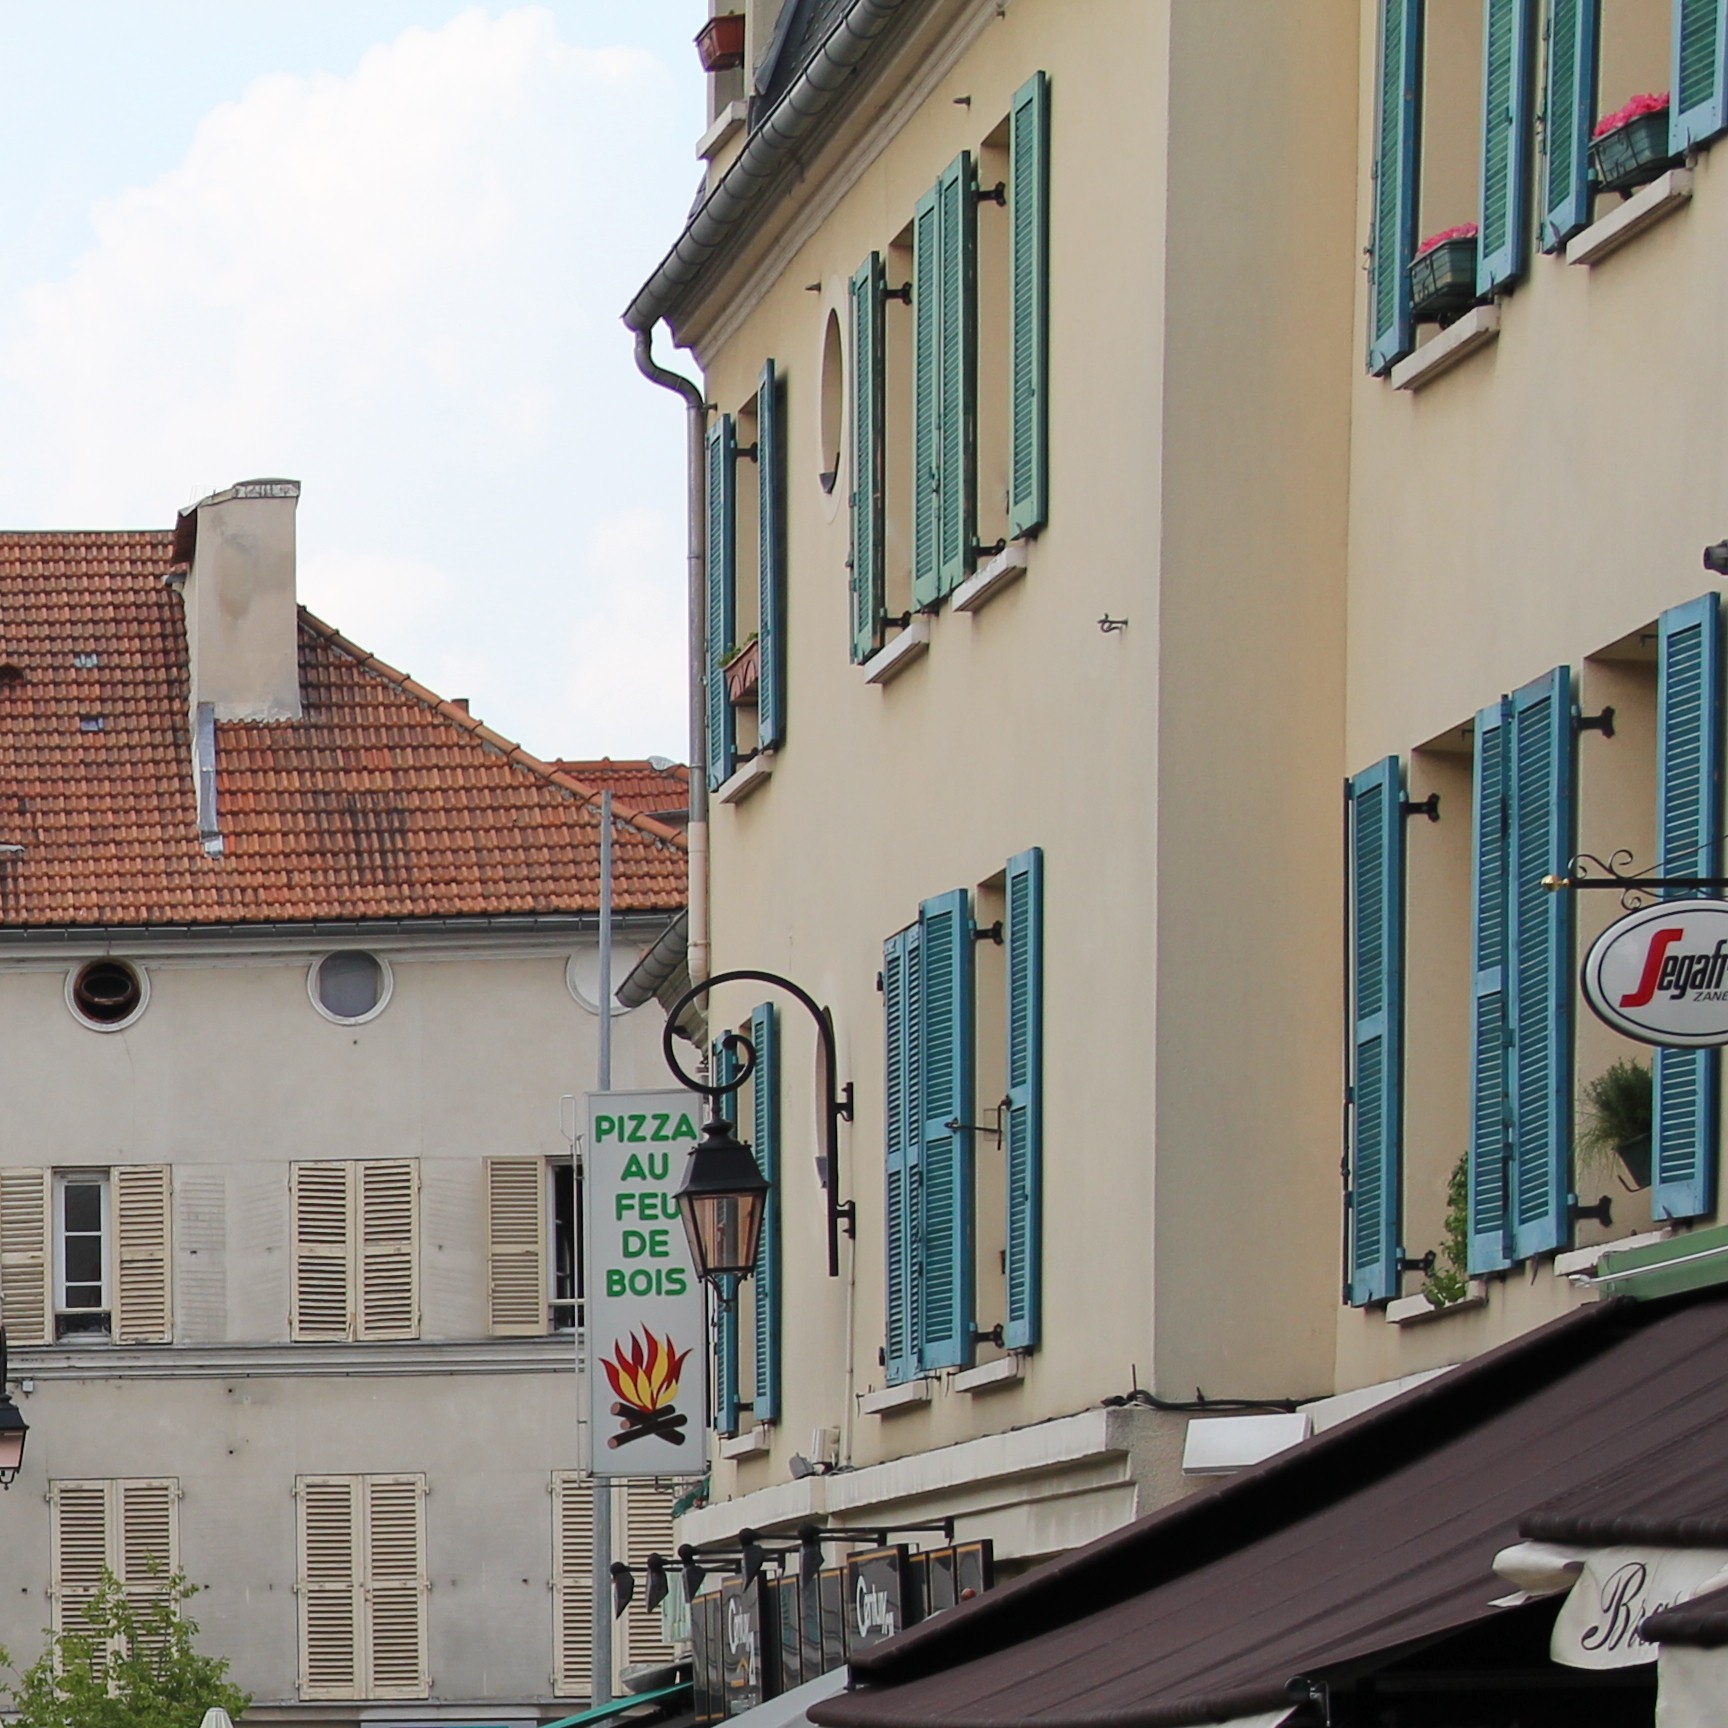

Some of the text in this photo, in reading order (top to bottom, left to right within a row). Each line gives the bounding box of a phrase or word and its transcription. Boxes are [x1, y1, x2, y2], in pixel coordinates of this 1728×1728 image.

[1619, 928, 1728, 1007] Segafr
[594, 1112, 697, 1143] PIZZA
[620, 1152, 669, 1182] AU
[615, 1192, 681, 1221] FEU
[622, 1229, 670, 1259] DE
[606, 1267, 687, 1298] BOIS
